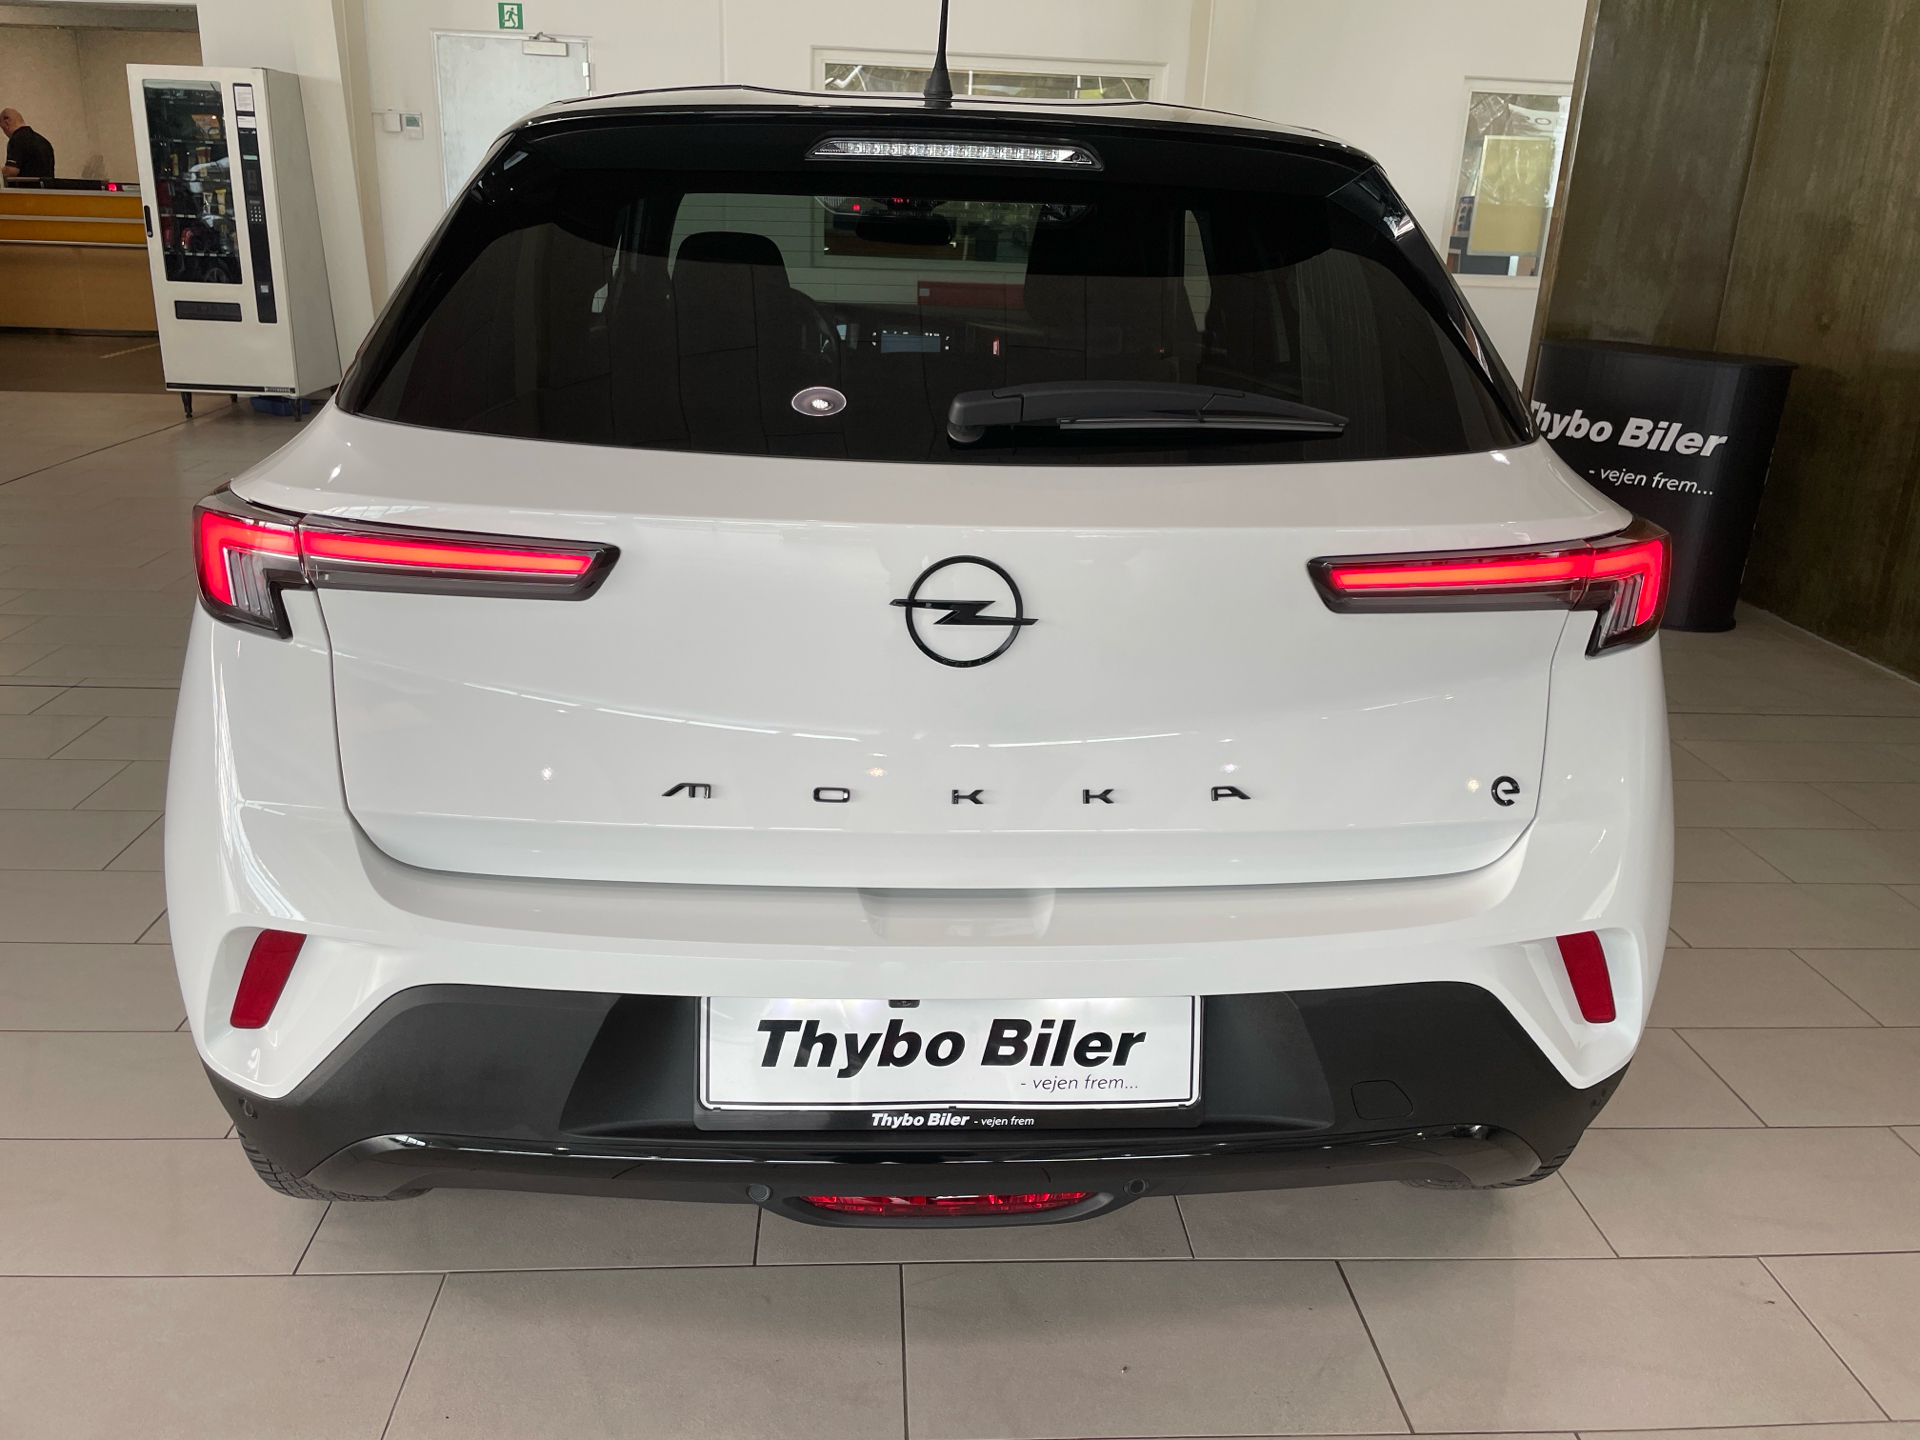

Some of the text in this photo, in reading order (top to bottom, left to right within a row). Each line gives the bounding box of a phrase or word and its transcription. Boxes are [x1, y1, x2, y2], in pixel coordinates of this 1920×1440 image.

[1618, 417, 1728, 456] Biler
[1600, 468, 1646, 486] vejen
[1651, 472, 1713, 495] frem...
[661, 782, 1251, 805] MOKKA
[1491, 775, 1520, 807] e
[757, 1019, 1146, 1078] Thybo Biler
[1032, 1076, 1078, 1093] vejen
[1084, 1075, 1139, 1090] frem...
[871, 1113, 924, 1128] Thybo
[927, 1113, 970, 1126] Biler
[981, 1117, 1008, 1127] vejen
[1010, 1116, 1034, 1125] frem
